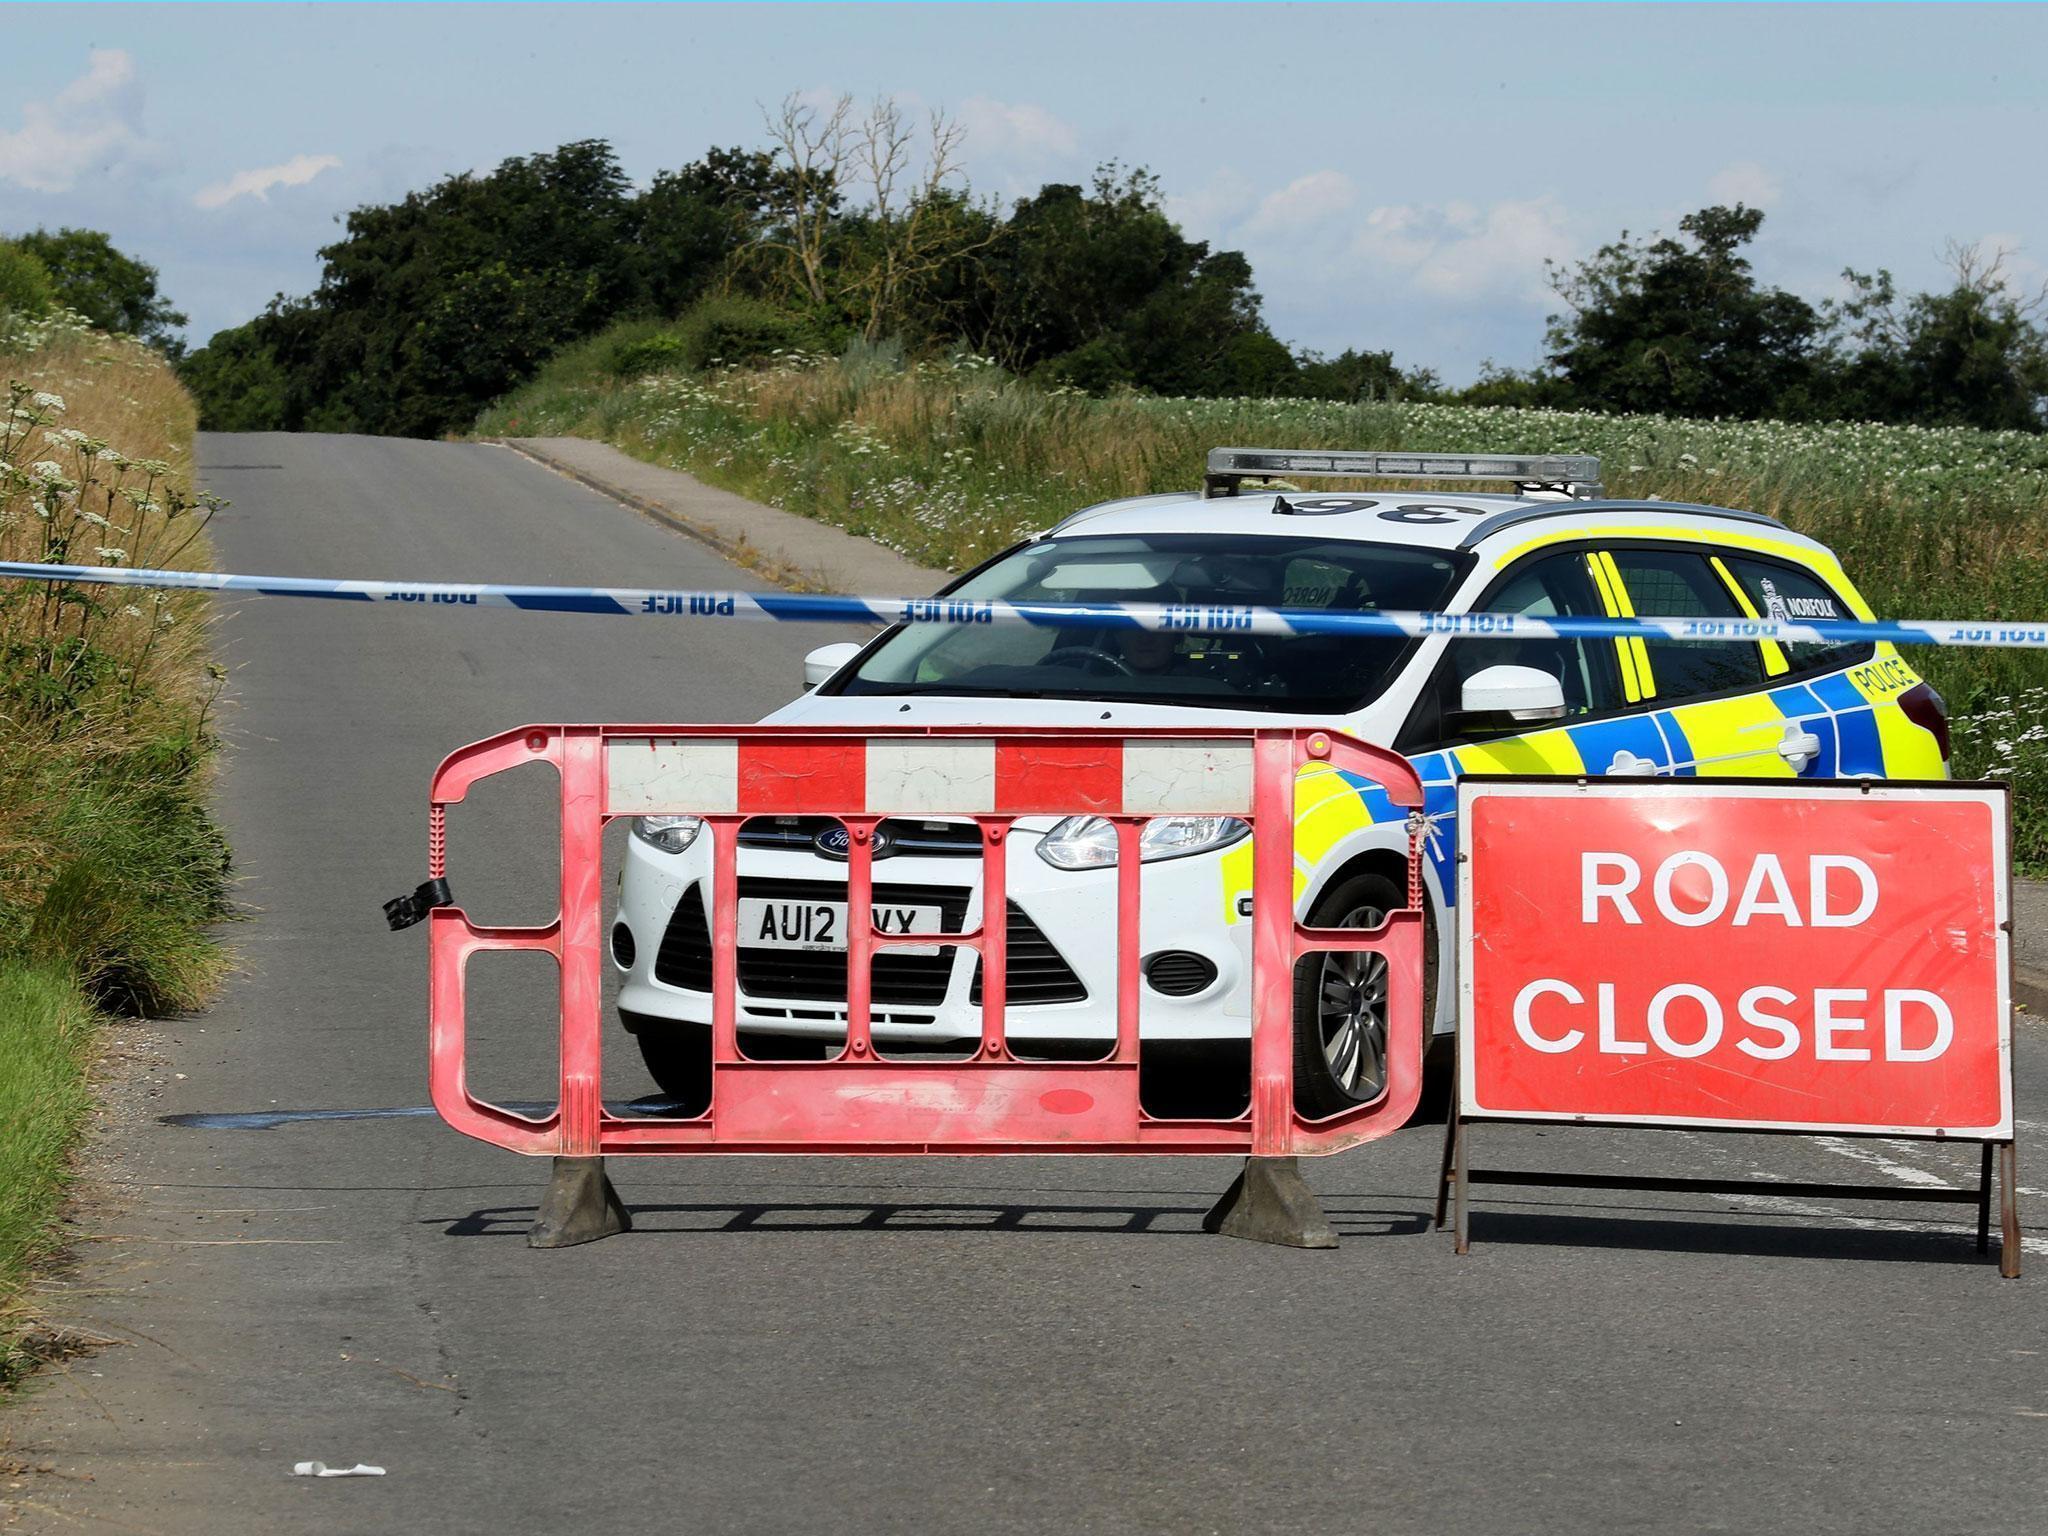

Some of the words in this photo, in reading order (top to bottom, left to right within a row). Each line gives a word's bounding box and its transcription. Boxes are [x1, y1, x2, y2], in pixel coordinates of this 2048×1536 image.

[642, 593, 735, 616] POLICE
[899, 598, 993, 625] POLICE
[1157, 604, 1252, 631] POLICE
[1786, 597, 1838, 618] NORFOLK
[1420, 611, 1515, 635] POLICE
[1854, 659, 1915, 696] POLICE
[1580, 849, 1879, 929] ROAD
[759, 904, 835, 943] AU12
[871, 908, 917, 934] VX
[1512, 978, 1956, 1064] CLOSED
